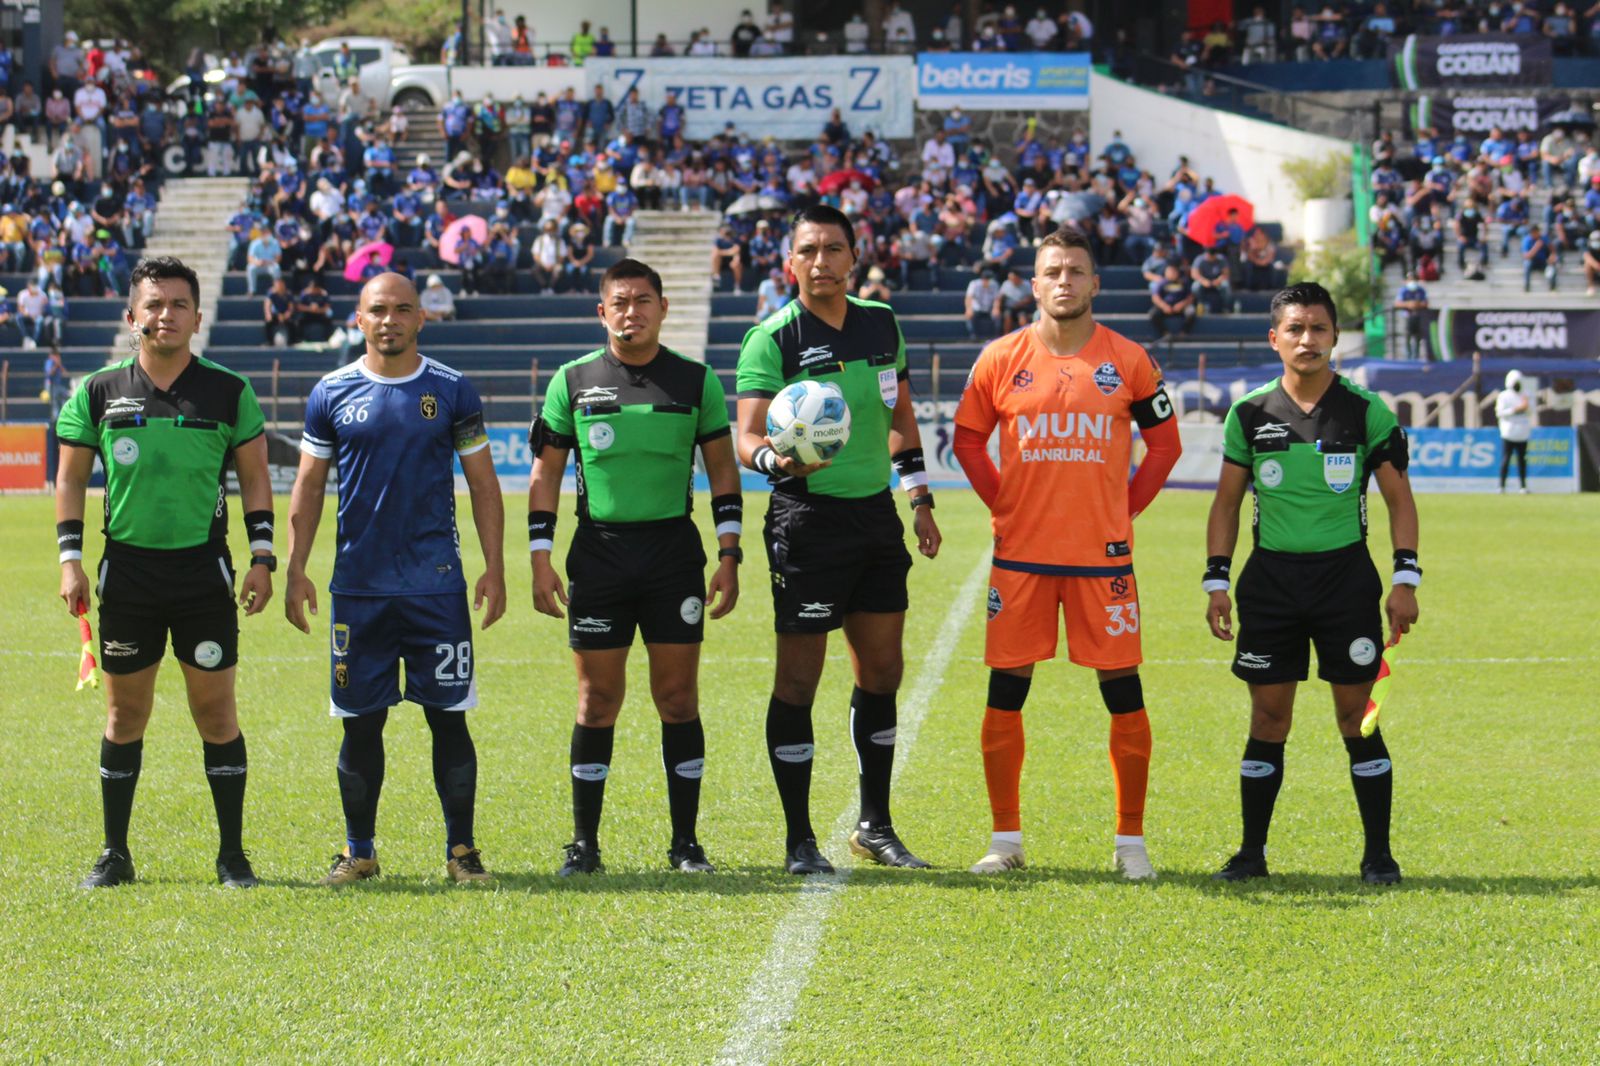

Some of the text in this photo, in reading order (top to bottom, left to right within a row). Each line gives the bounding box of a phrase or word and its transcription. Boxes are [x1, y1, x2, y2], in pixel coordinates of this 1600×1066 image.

[850, 66, 882, 111] Z
[922, 62, 1031, 89] betcris
[762, 84, 833, 110] GAS
[342, 403, 370, 424] 86
[1152, 394, 1171, 419] C
[813, 425, 844, 438] molten
[1017, 412, 1113, 441] MUNI
[1021, 447, 1106, 464] BANRURAL
[1327, 456, 1352, 466] FIFA
[1104, 602, 1139, 637] 33
[435, 640, 471, 680] 28
